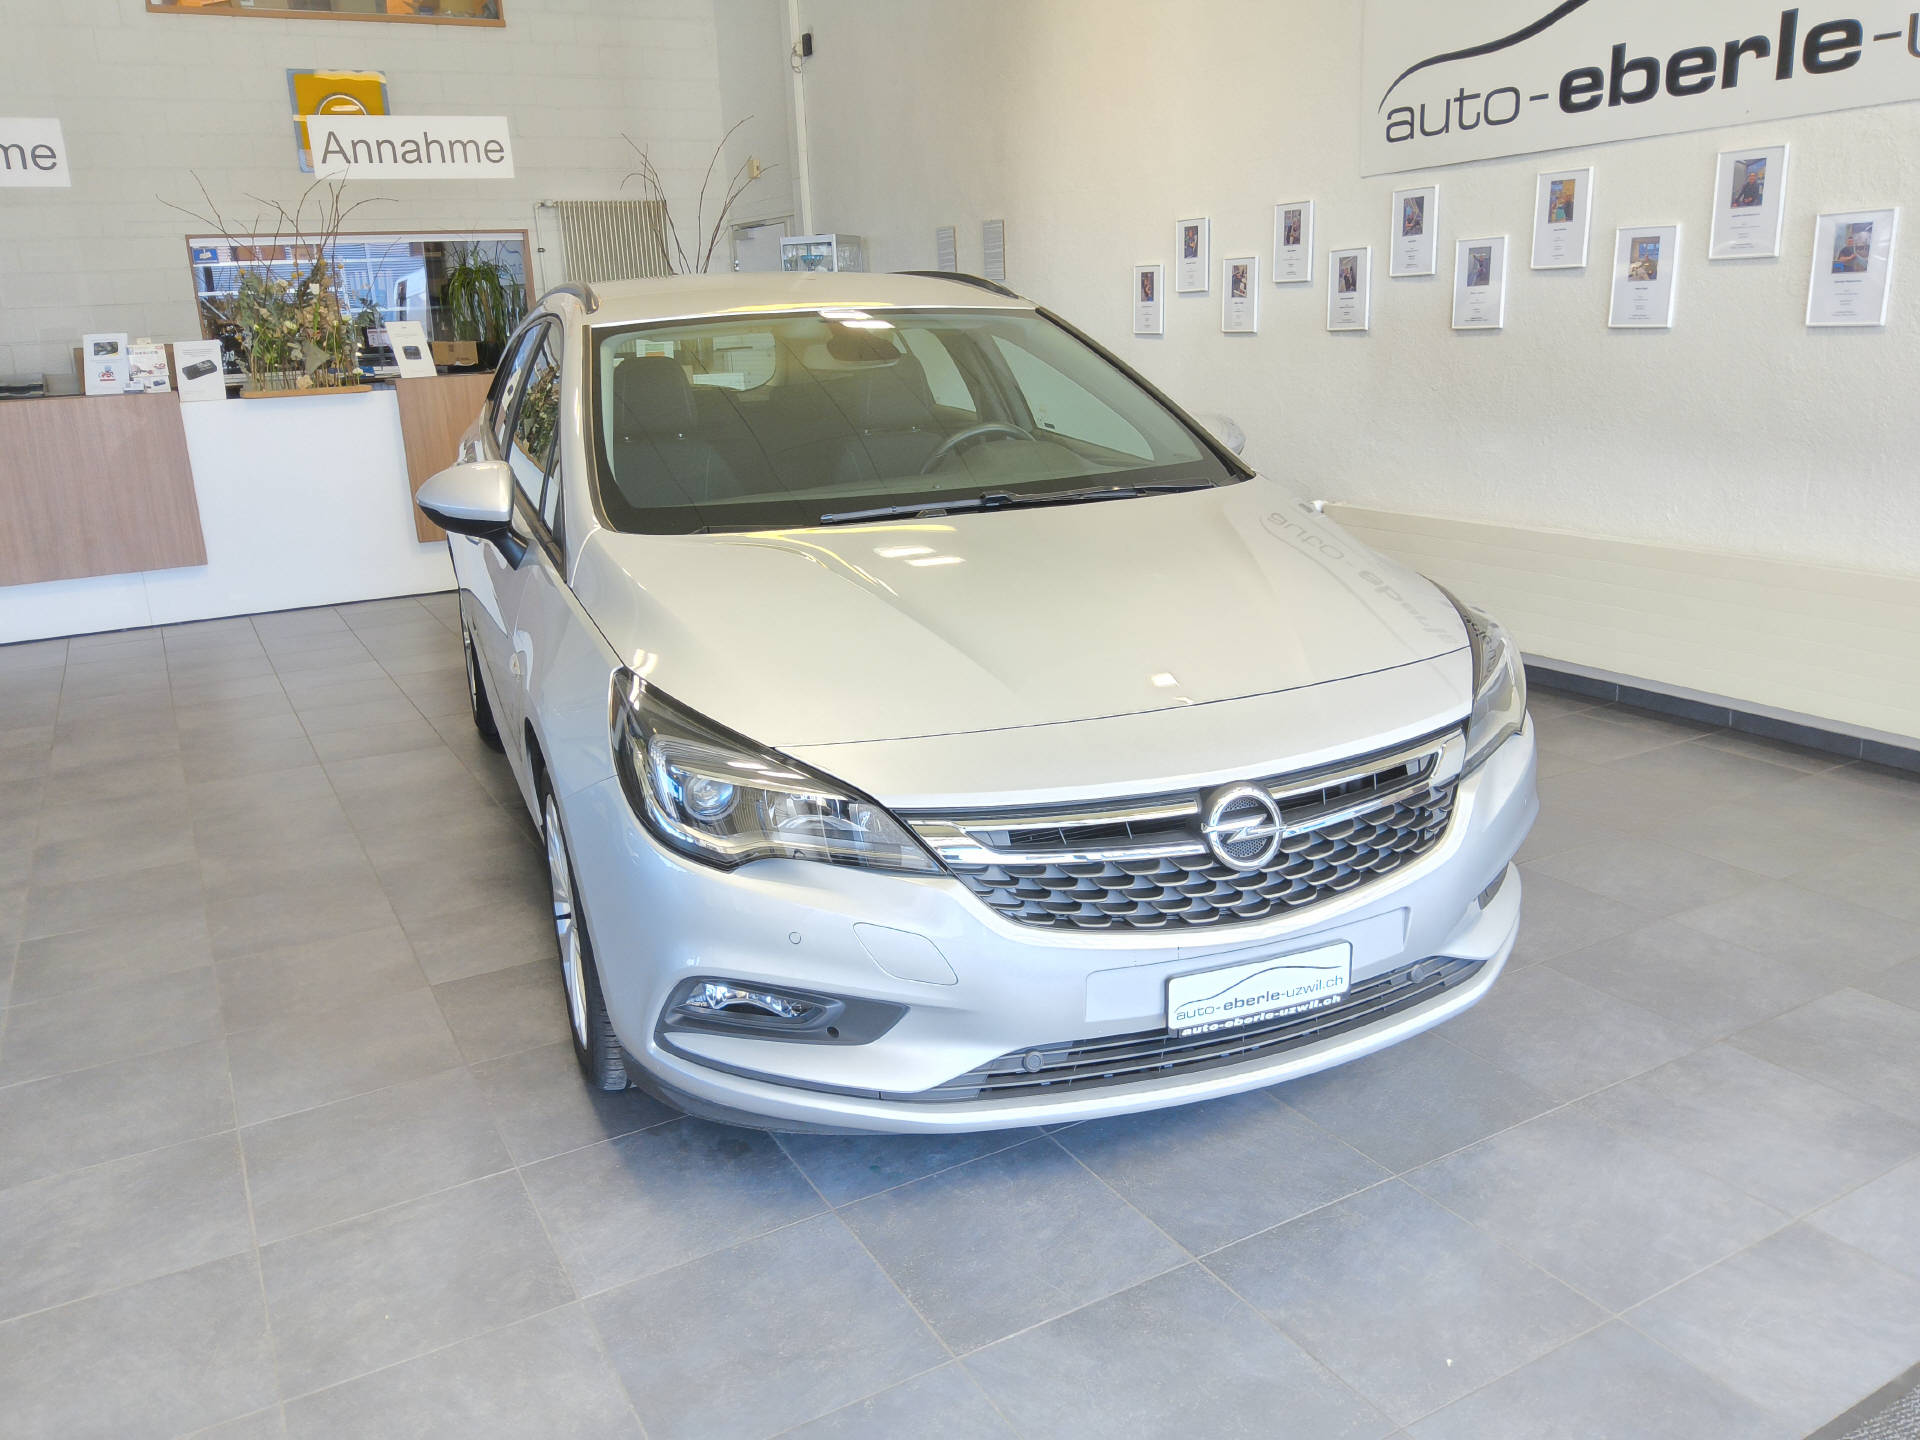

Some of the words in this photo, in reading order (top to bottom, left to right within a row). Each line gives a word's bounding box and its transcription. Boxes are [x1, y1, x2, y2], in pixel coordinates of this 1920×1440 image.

[321, 130, 505, 164] Annahme
[1175, 975, 1344, 1021] auto-eberle-uzwil.ch
[1181, 995, 1342, 1037] auto-eberle-uzwil.ch
